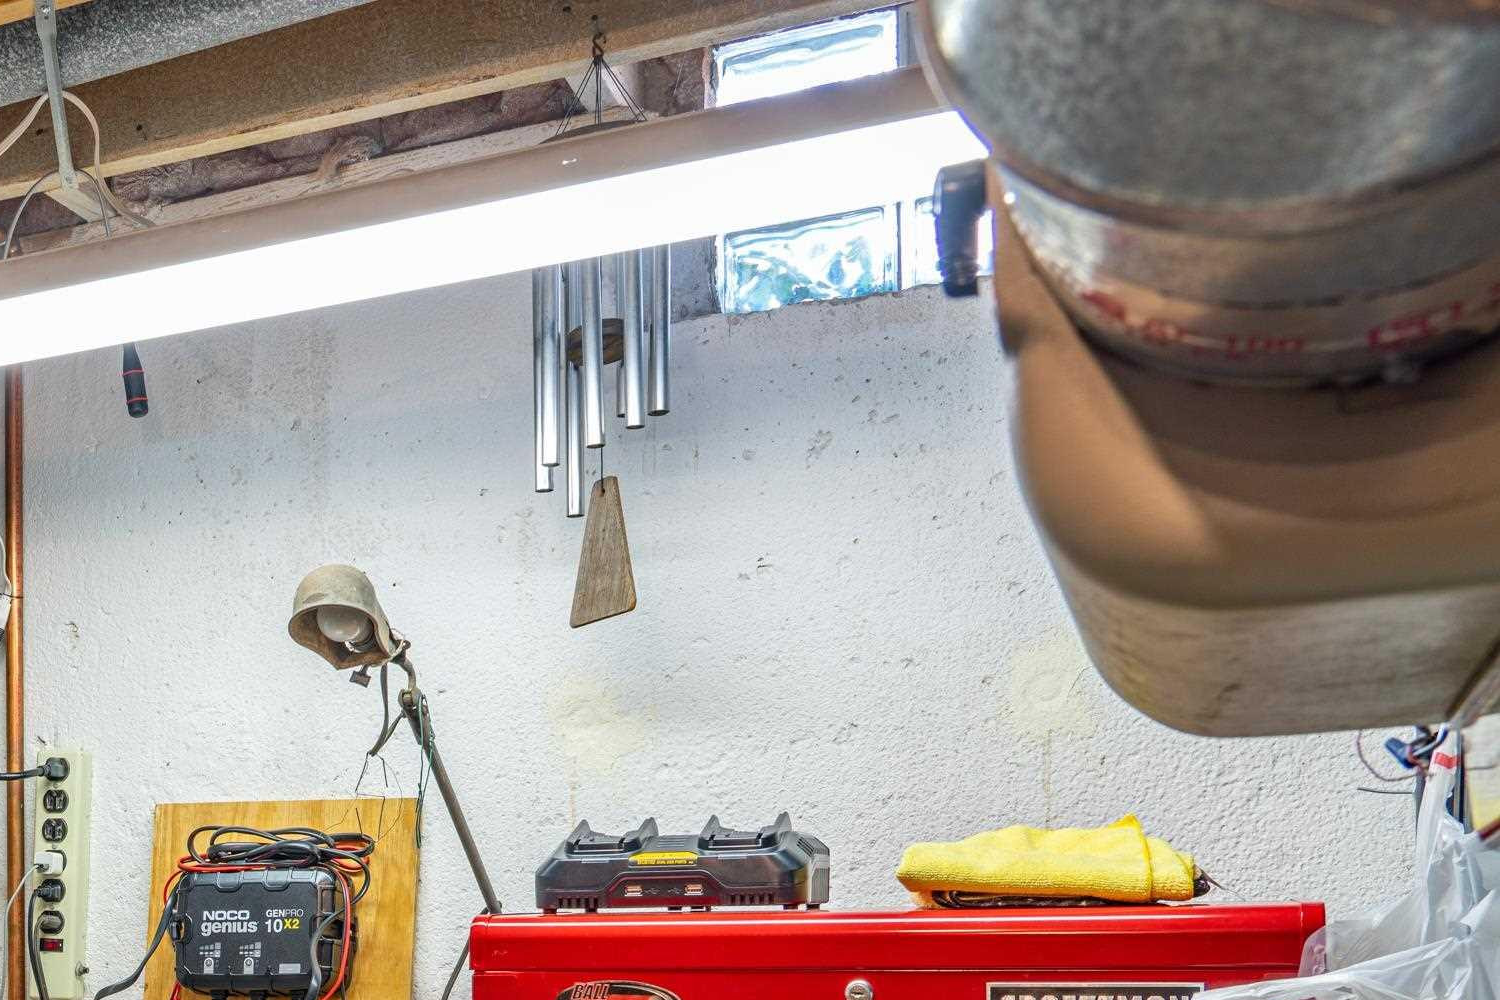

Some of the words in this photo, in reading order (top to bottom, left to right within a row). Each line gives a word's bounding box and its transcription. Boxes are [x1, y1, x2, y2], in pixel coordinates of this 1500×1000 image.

[202, 909, 250, 921] NOCO
[265, 908, 304, 918] GENPRO
[201, 921, 257, 937] genius
[570, 982, 610, 1000] BALL
